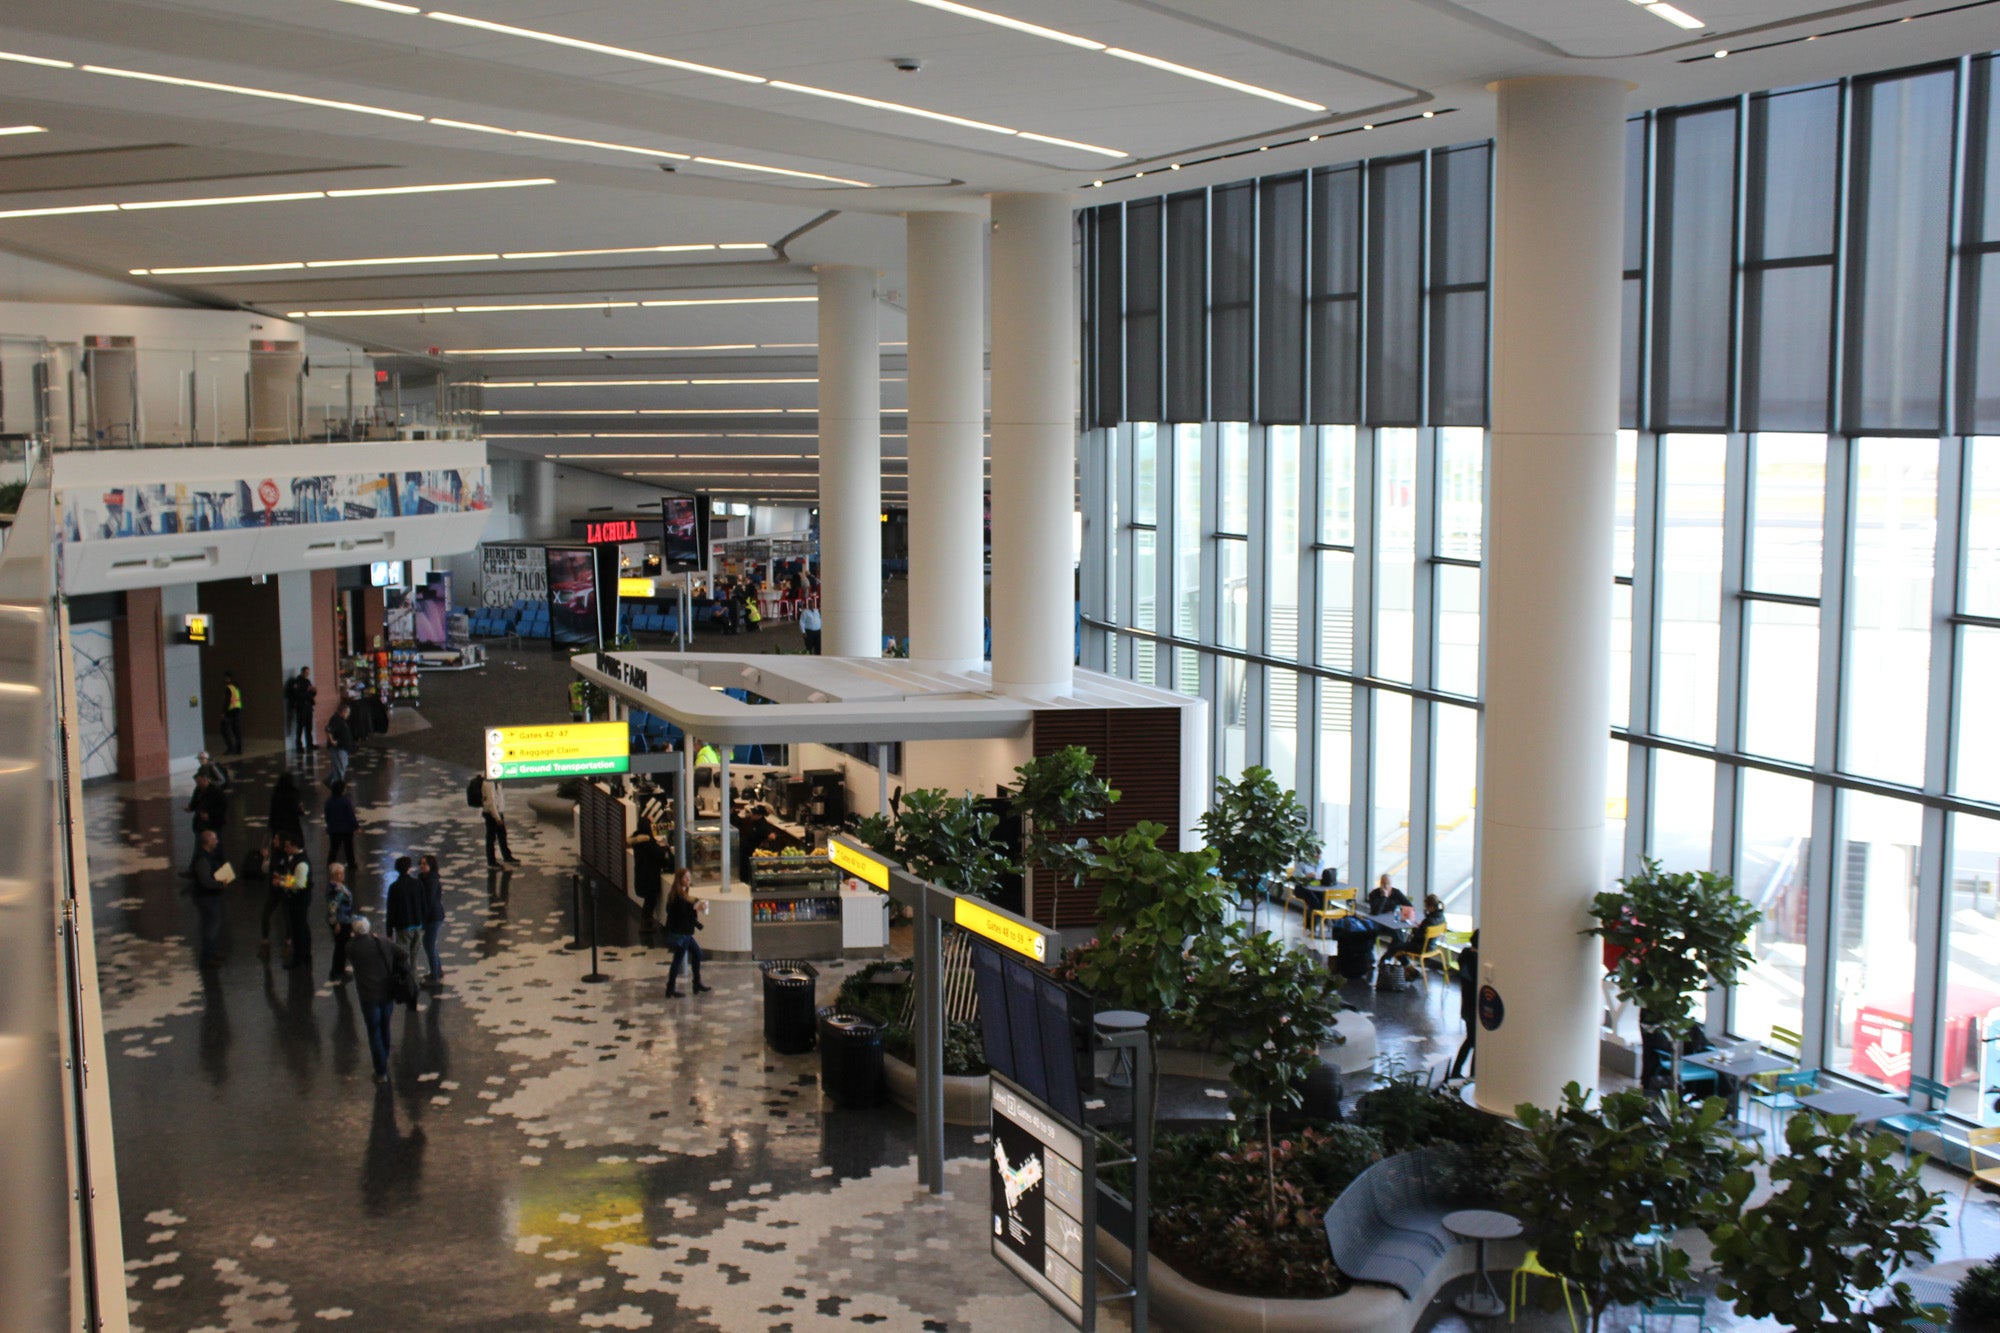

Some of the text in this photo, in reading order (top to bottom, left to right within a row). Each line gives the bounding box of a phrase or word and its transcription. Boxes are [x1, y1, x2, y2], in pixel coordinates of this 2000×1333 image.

[587, 521, 637, 543] LA CHULA
[484, 548, 526, 560] BURRITOS
[483, 559, 516, 575] CHIPS
[517, 571, 546, 591] TACOS
[624, 663, 647, 692] FARM
[519, 731, 542, 740] Gates
[519, 746, 580, 757] Baggage Claim
[519, 760, 615, 773] Ground Transportation
